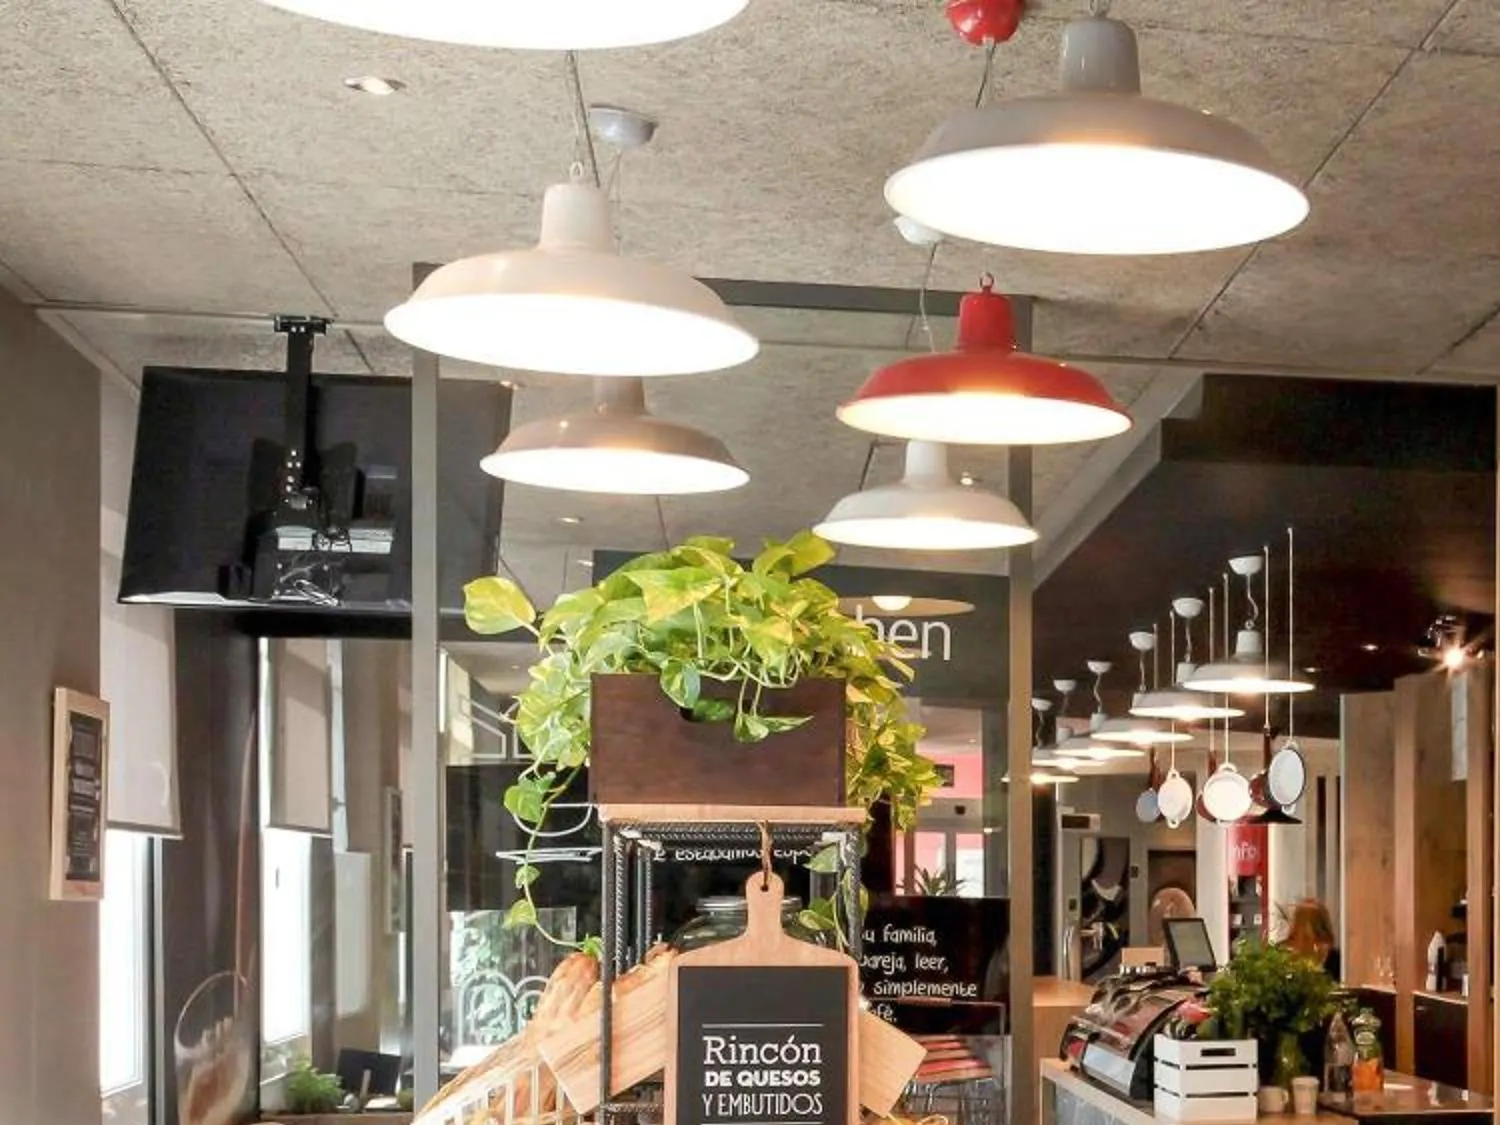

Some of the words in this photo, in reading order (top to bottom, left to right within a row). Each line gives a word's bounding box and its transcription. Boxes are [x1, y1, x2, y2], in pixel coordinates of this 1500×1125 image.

[883, 923, 938, 947] familia,
[915, 953, 949, 974] leer,
[873, 979, 978, 998] simplemente
[702, 1034, 823, 1065] Rincón
[705, 1070, 733, 1087] DE
[737, 1069, 821, 1088] QUESOS
[702, 1093, 713, 1117] Y
[718, 1092, 824, 1117] EMBUTIDOS
